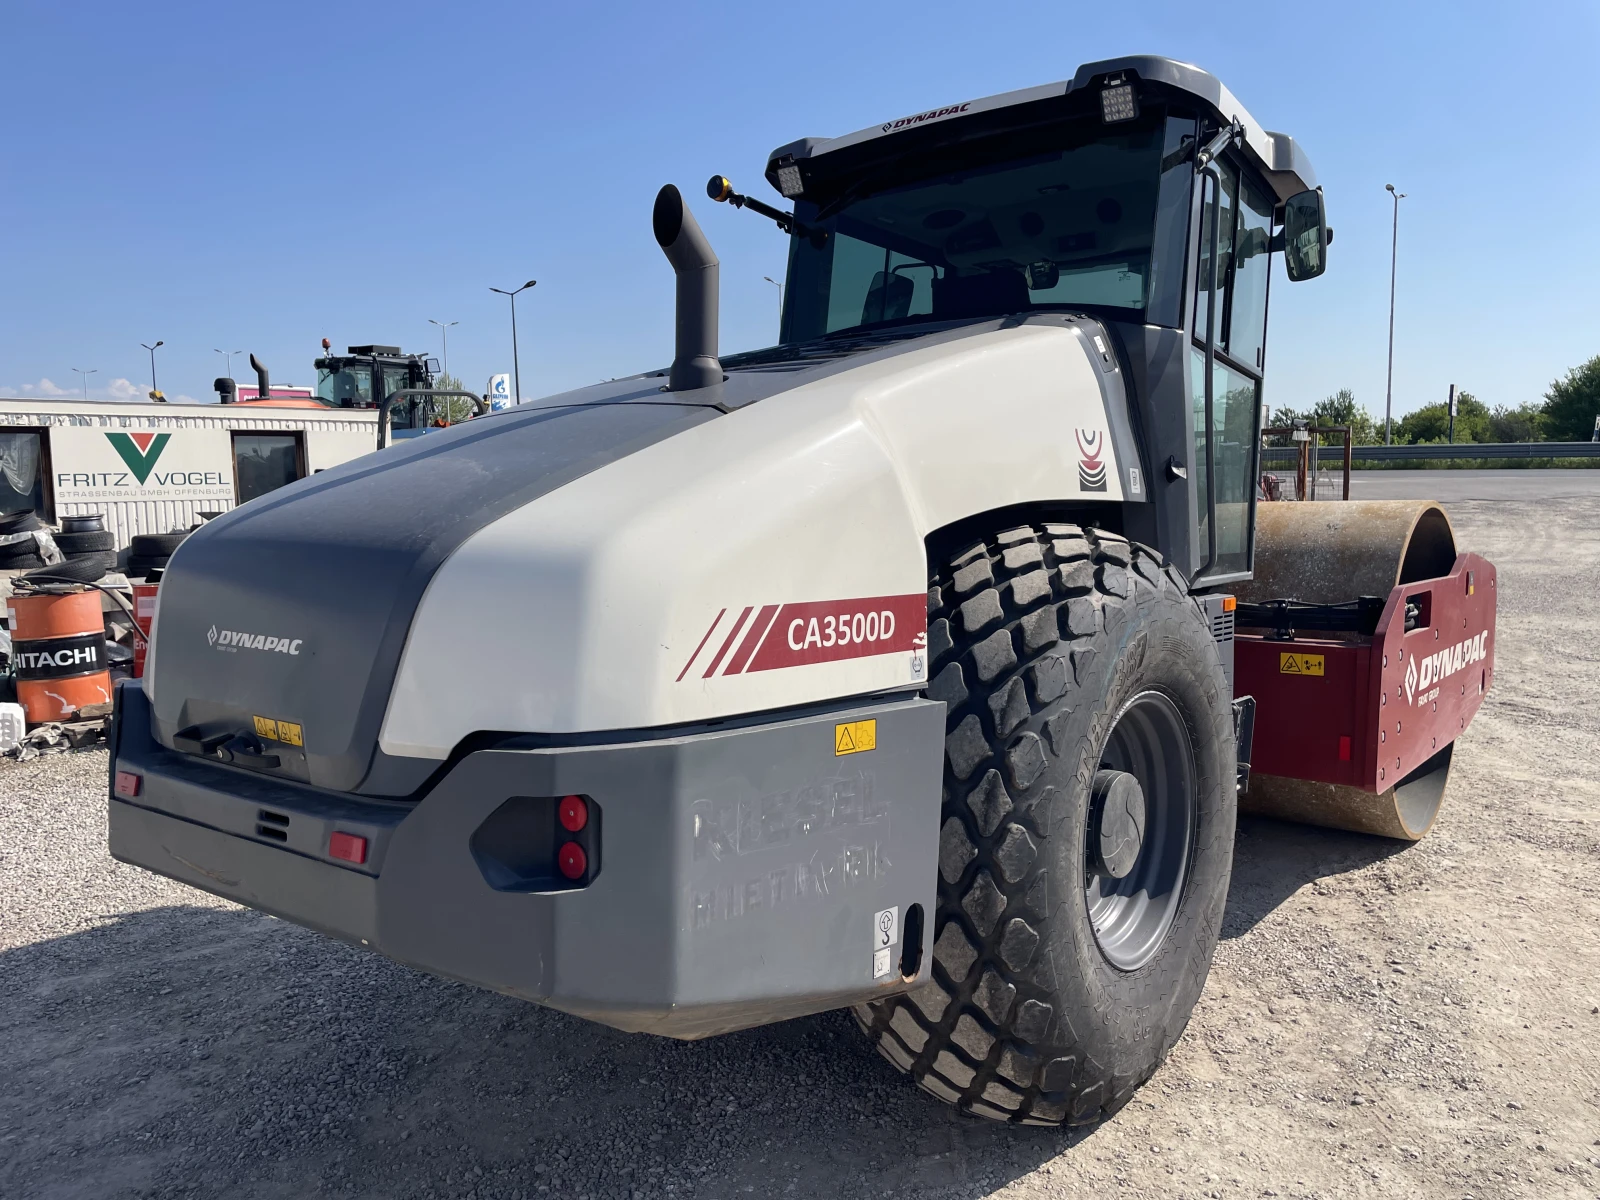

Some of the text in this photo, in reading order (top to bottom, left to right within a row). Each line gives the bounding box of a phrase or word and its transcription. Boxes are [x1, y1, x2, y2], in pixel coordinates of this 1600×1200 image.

[893, 102, 971, 129] DYNAPAC
[57, 471, 230, 487] FRITZ VOGEL
[58, 490, 137, 498] STRASSENBAU
[174, 487, 232, 495] OFFENBURG
[218, 630, 303, 655] DYNAPAC
[787, 610, 896, 651] CA3500D
[14, 646, 97, 669] HITACHI
[1418, 629, 1489, 692] DYNAPAC
